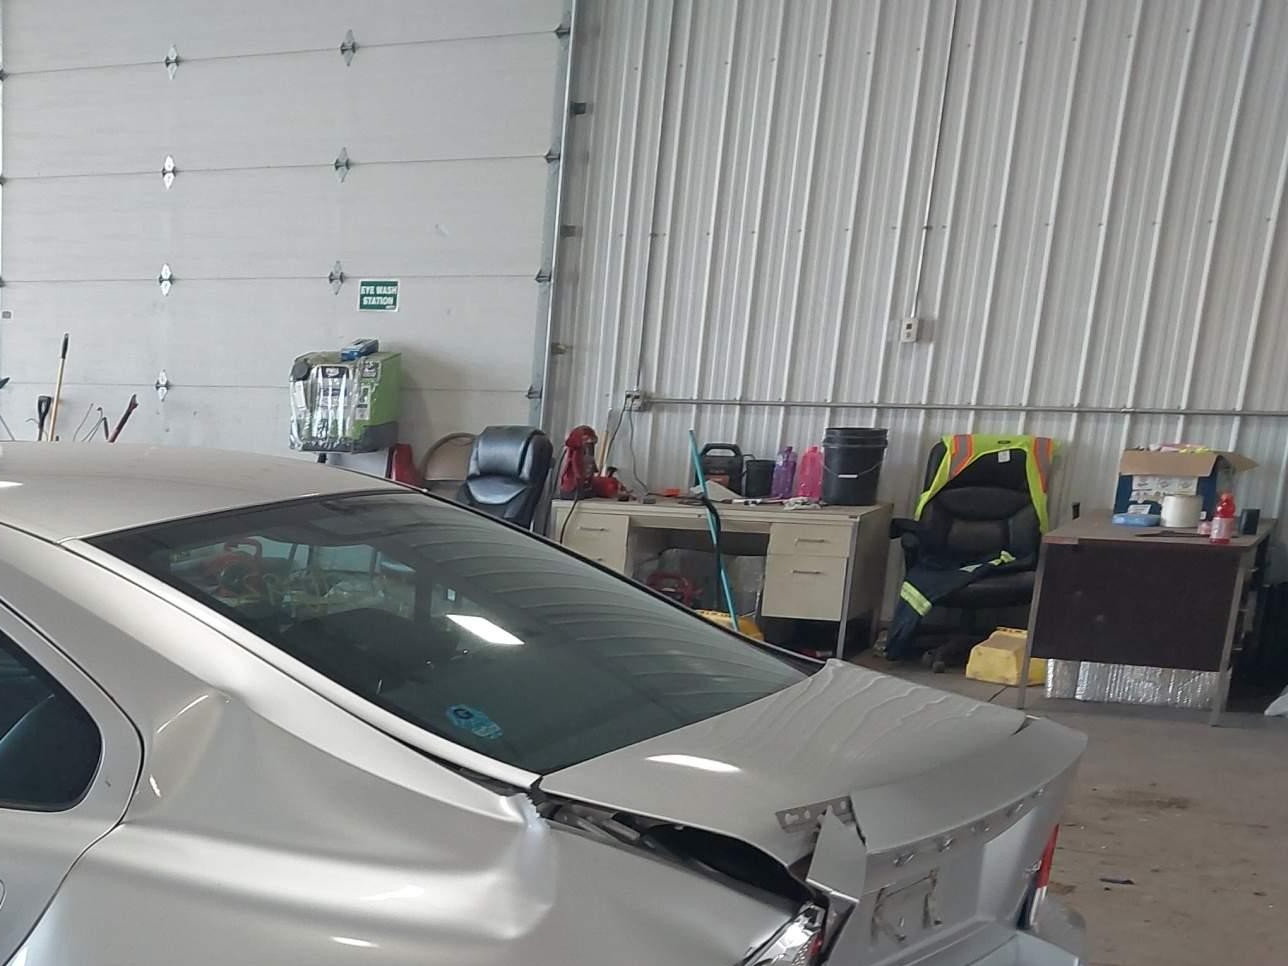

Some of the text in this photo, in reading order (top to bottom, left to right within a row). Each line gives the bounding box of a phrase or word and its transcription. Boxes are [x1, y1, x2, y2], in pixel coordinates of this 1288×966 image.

[360, 285, 397, 295] EYE WASH
[363, 296, 394, 305] STATION
